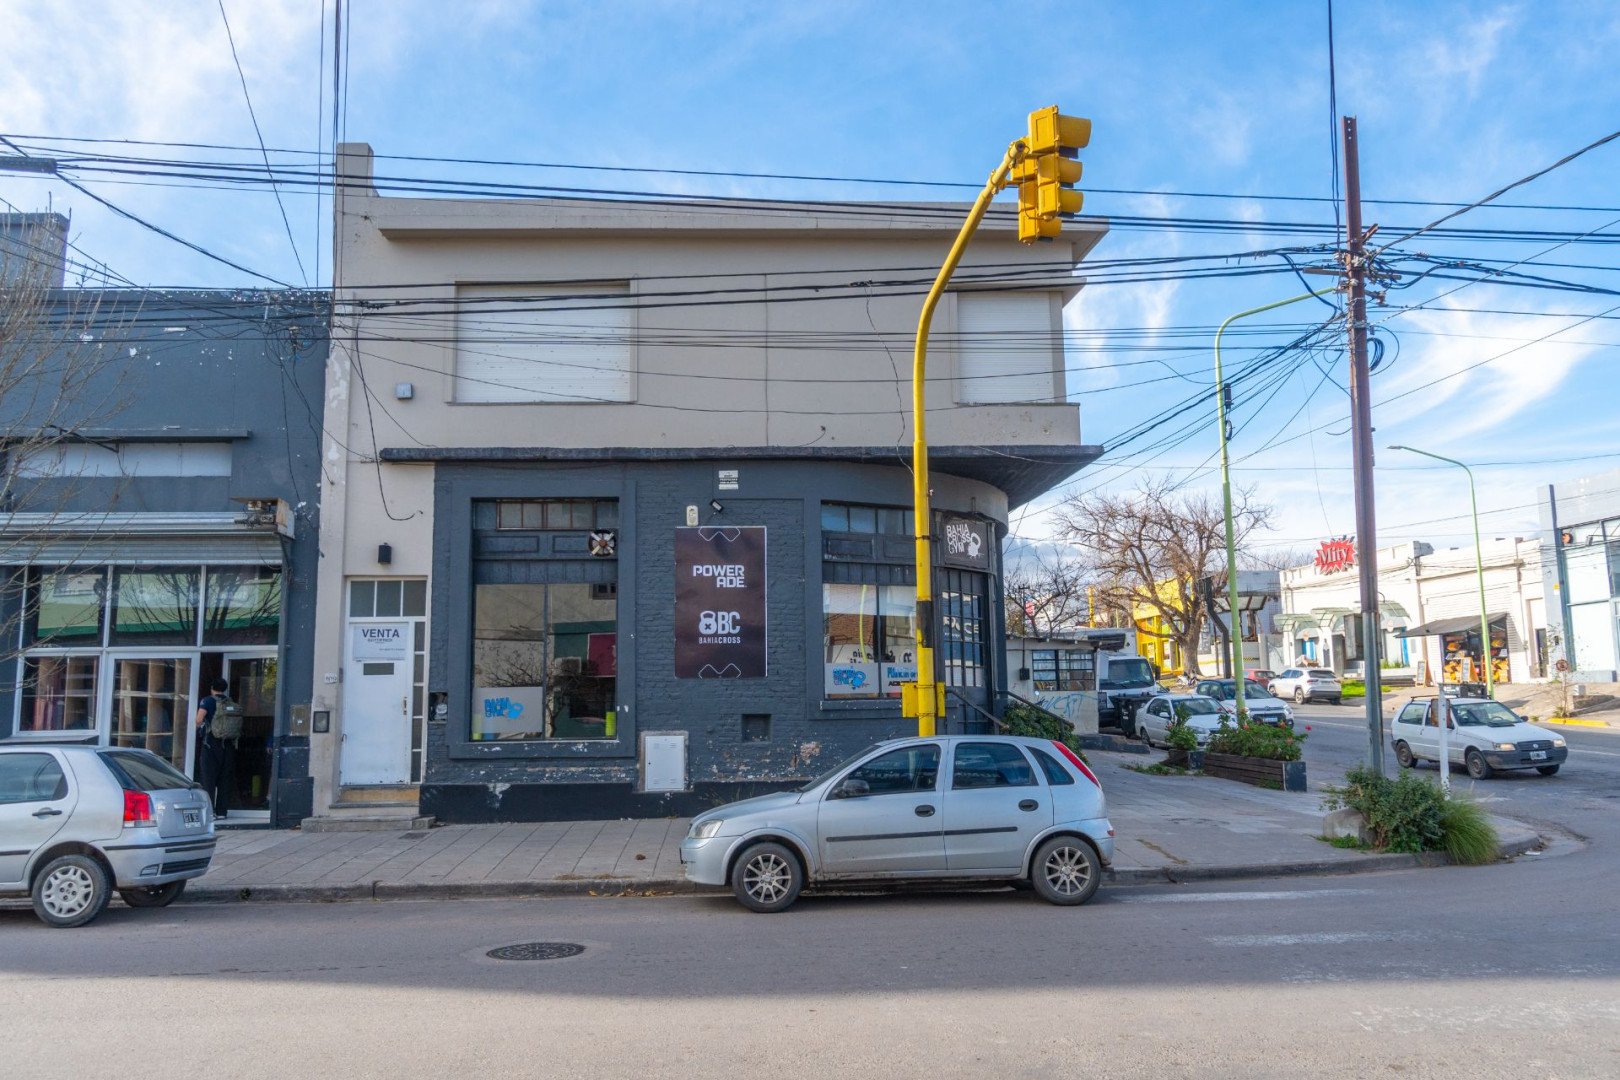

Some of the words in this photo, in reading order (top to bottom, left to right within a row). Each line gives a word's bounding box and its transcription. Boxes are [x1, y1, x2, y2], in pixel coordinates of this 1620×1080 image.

[948, 541, 965, 554] GYM
[692, 564, 745, 577] POWER
[716, 576, 745, 588] ADE
[717, 611, 741, 634] BC
[361, 628, 400, 638] VENTA
[698, 636, 741, 644] BAHIACROSS
